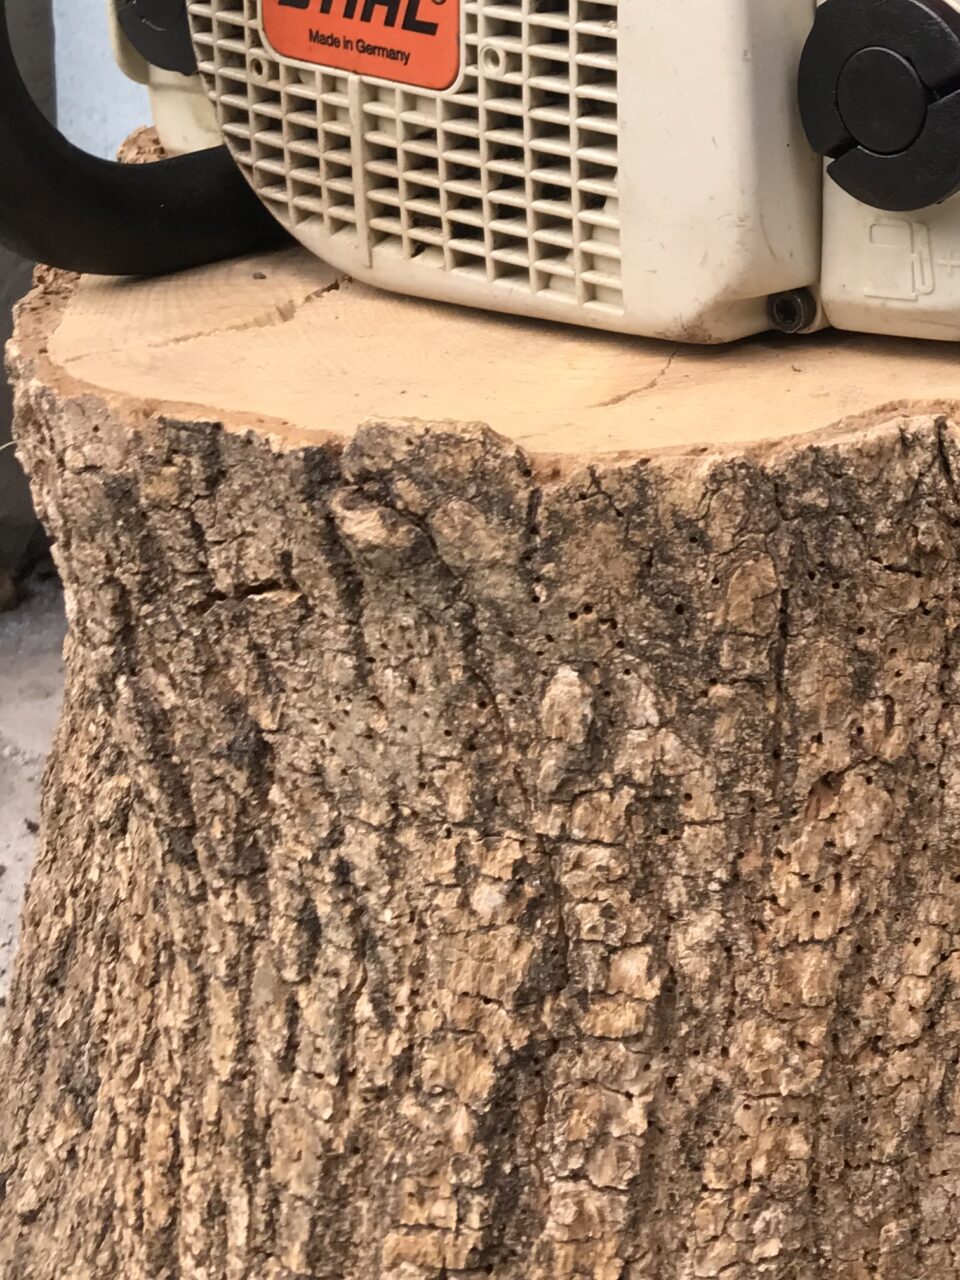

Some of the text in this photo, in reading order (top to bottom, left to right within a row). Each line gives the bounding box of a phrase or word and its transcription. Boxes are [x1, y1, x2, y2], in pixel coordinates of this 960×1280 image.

[308, 28, 411, 66] Made in Germany
